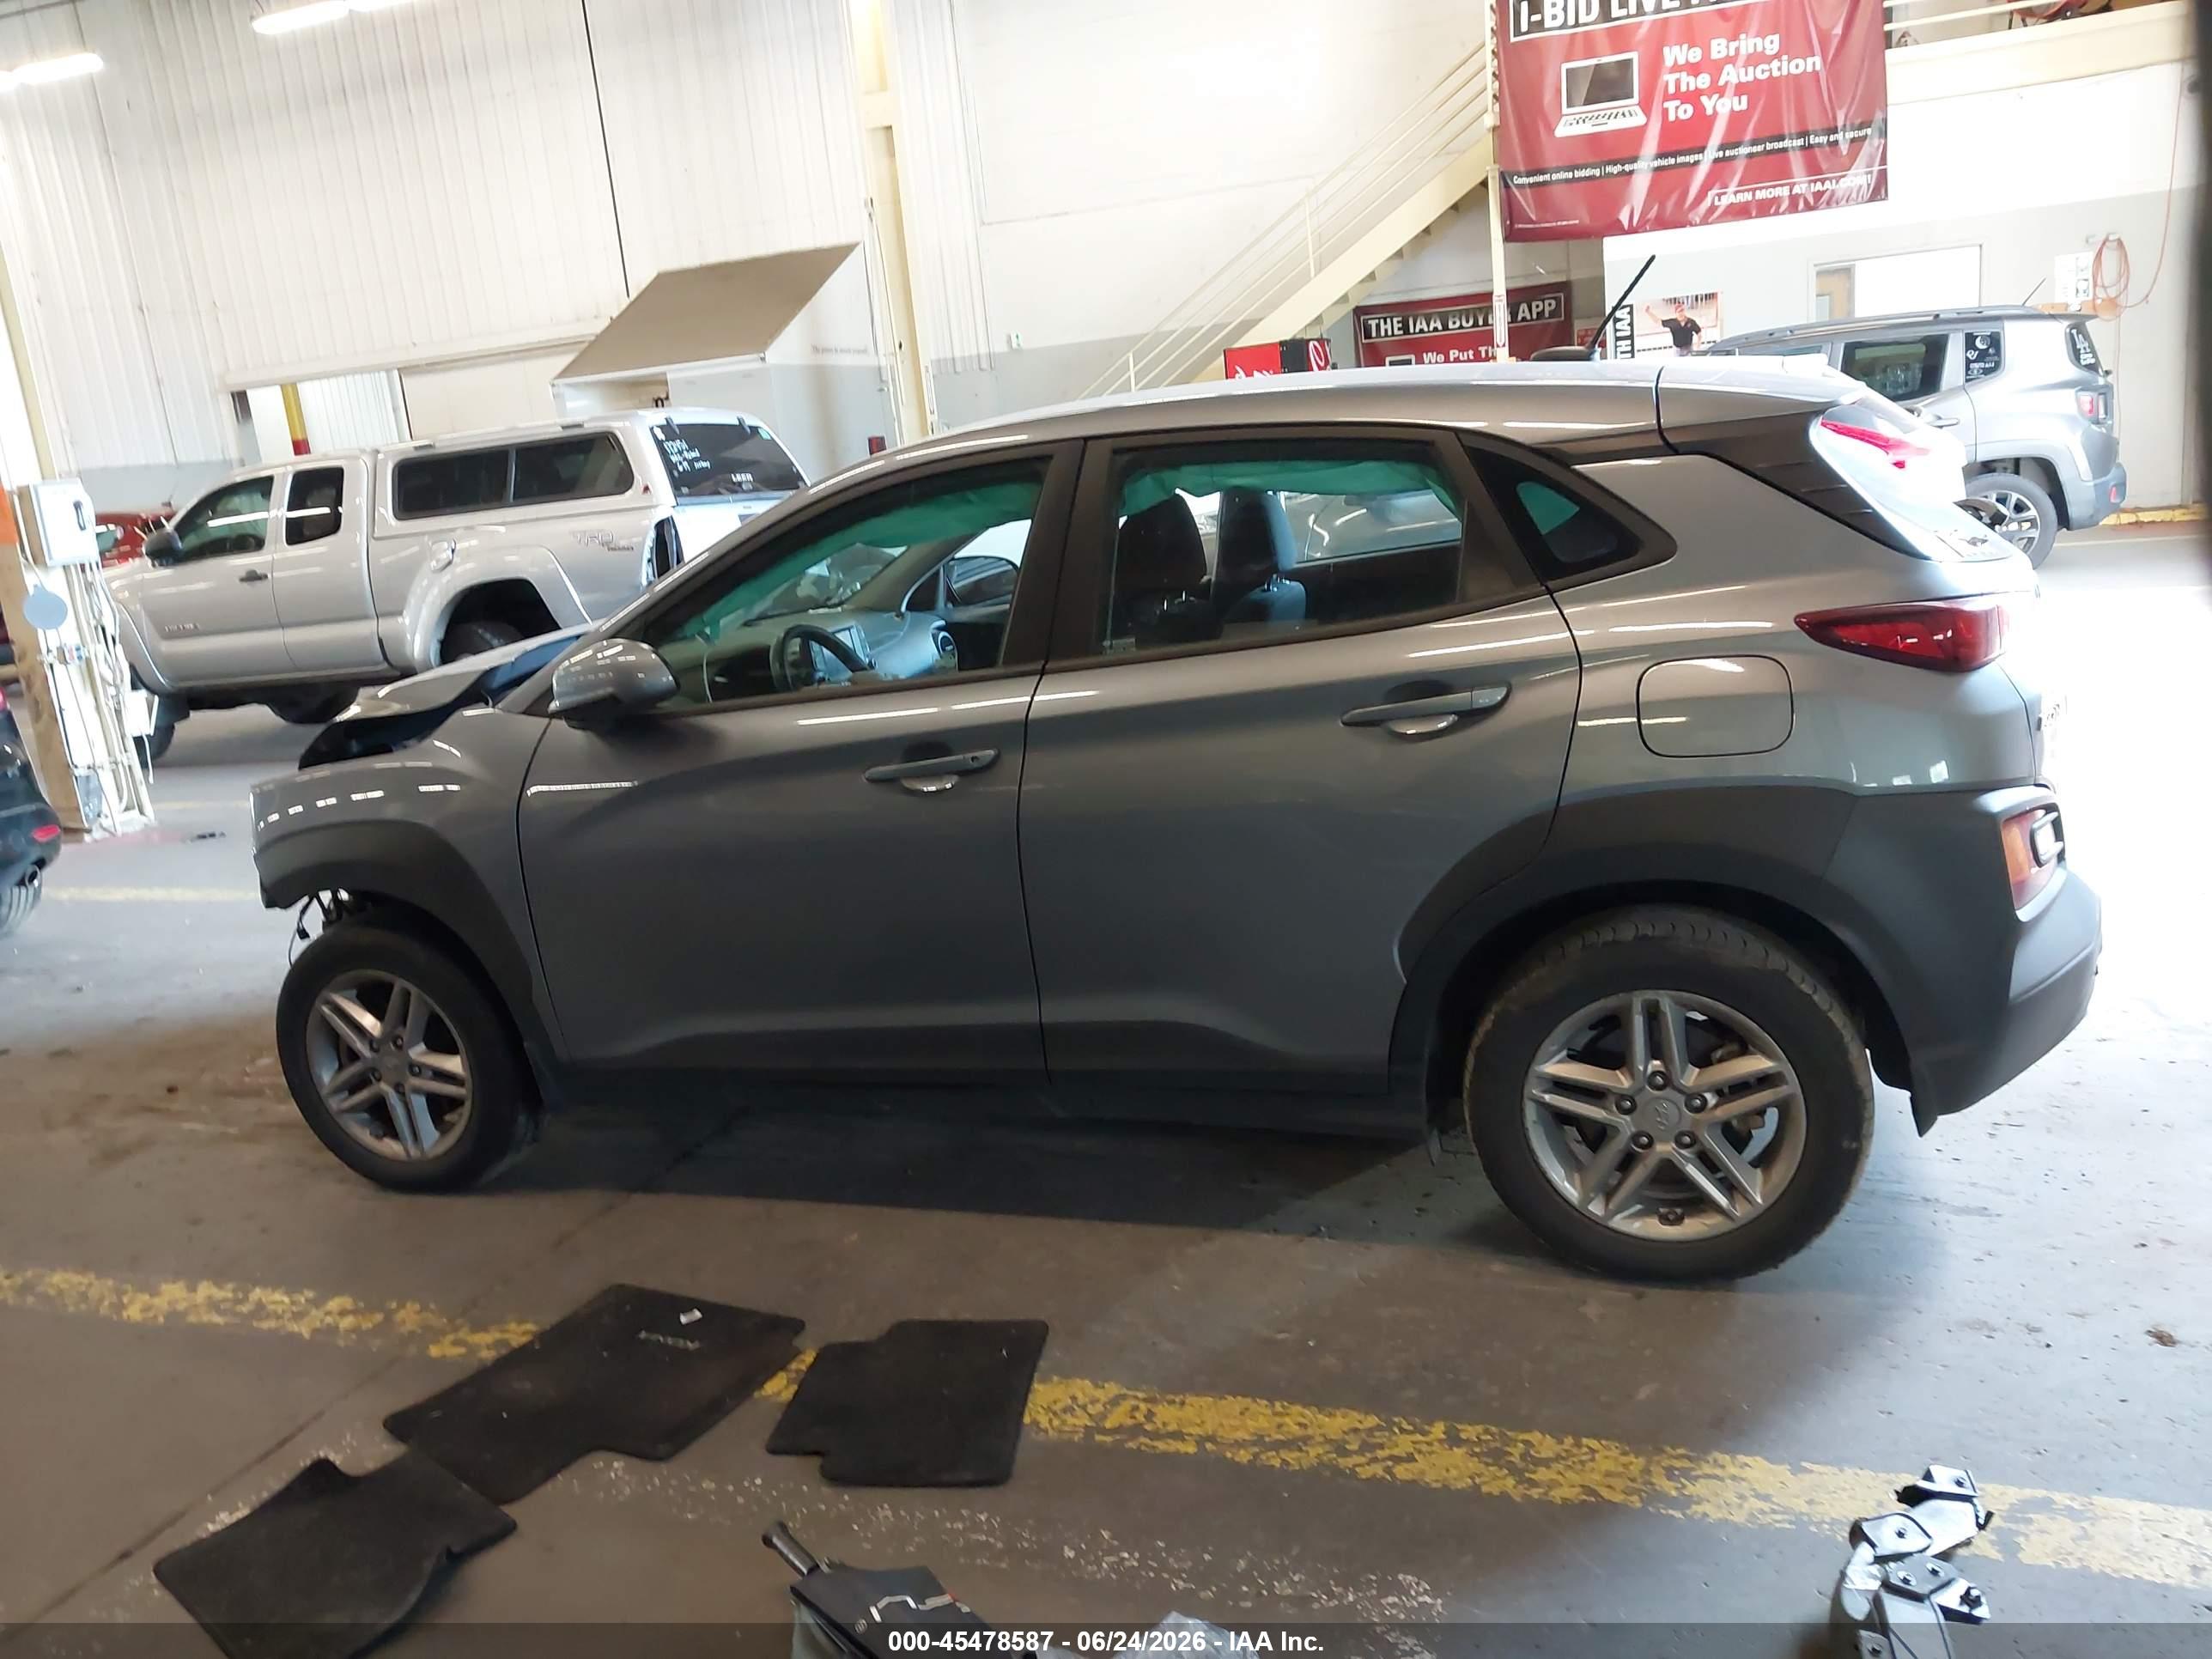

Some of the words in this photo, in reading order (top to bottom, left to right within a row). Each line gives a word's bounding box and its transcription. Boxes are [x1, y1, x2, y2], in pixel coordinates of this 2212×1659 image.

[1520, 0, 1600, 33] I-BID
[1611, 0, 1680, 18] LI
[1662, 44, 1703, 68] We
[1710, 33, 1780, 60] Bring
[1662, 71, 1711, 94] The
[1717, 54, 1821, 86] Auction
[1662, 100, 1694, 122] To
[1699, 93, 1749, 116] You
[1513, 173, 1551, 185] Convenient
[1551, 169, 1573, 180] online
[1574, 166, 1601, 179] bidding
[1605, 158, 1648, 174] High-quality
[1649, 155, 1675, 168] vehicle
[1676, 152, 1703, 166] images
[1724, 143, 1765, 157] auctioneer
[1765, 137, 1804, 150] broadcast
[1809, 133, 1828, 145] Easy
[1829, 130, 1844, 142] and
[1844, 127, 1872, 139] secure
[1714, 191, 1754, 206] LEARN
[1754, 185, 1790, 200] MORE
[1792, 182, 1808, 194] AT
[1368, 316, 1404, 337] THE
[1408, 313, 1443, 333] IAA
[1448, 307, 1511, 330] BUY
[1517, 299, 1558, 322] APP
[1423, 351, 1443, 364] We
[1449, 348, 1474, 362] Put
[1478, 345, 1497, 359] Th
